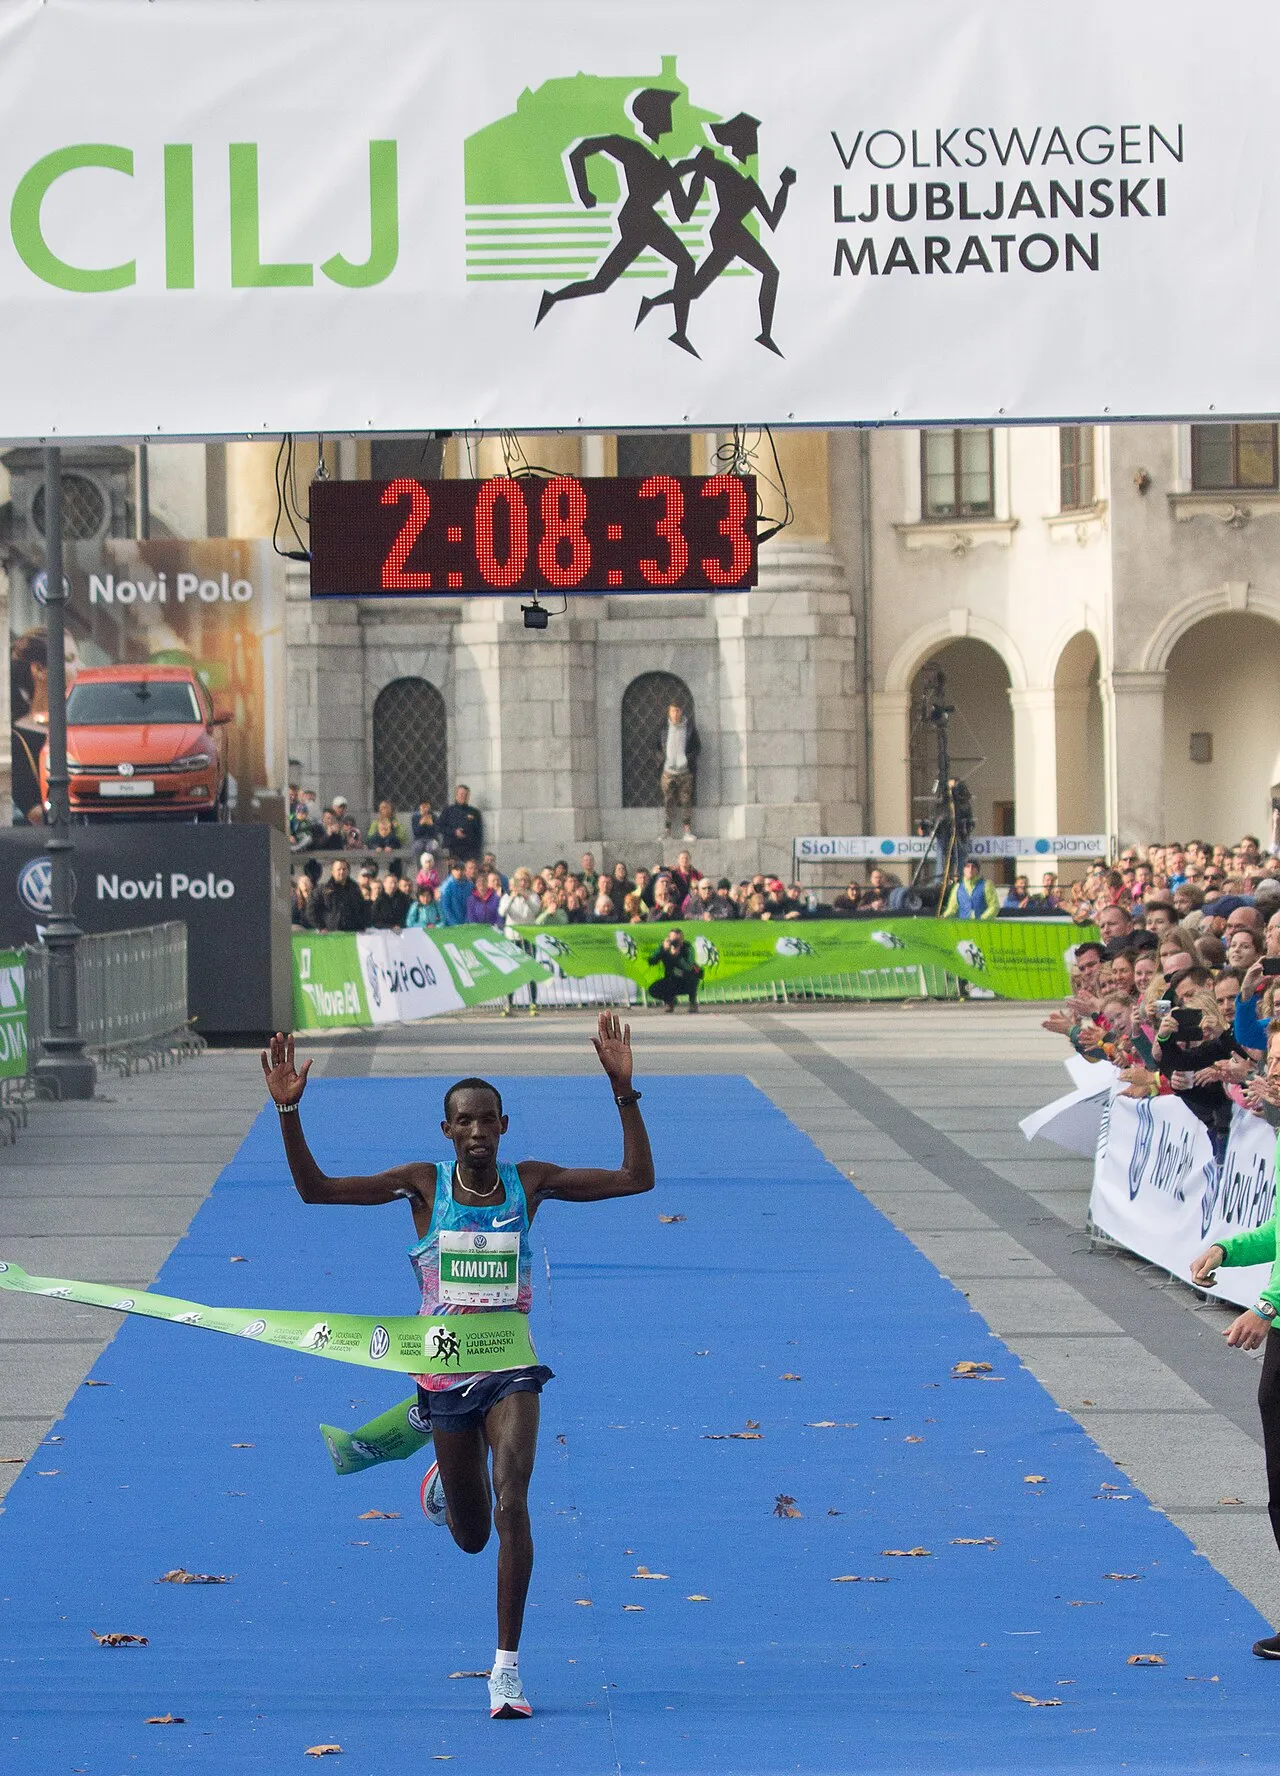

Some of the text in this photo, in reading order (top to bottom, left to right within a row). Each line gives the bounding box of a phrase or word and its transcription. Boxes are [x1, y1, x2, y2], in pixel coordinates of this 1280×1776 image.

[830, 124, 1184, 170] VOLKSWAGEN
[10, 140, 399, 293] CILJ
[834, 178, 1167, 223] LJUBLJANSKI
[833, 233, 1100, 276] MARATON
[380, 475, 752, 589] 2:08:33
[89, 572, 253, 604] Novi Polo
[1053, 839, 1101, 855] planet
[96, 873, 163, 900] Novi
[170, 873, 235, 900] Polo
[1220, 1151, 1257, 1227] Novi
[451, 1260, 508, 1278] KIMUTAI
[465, 1330, 515, 1341] VOLKSWAGEN
[466, 1339, 514, 1348] LJUBLJANSKI
[466, 1346, 505, 1356] MARATON
